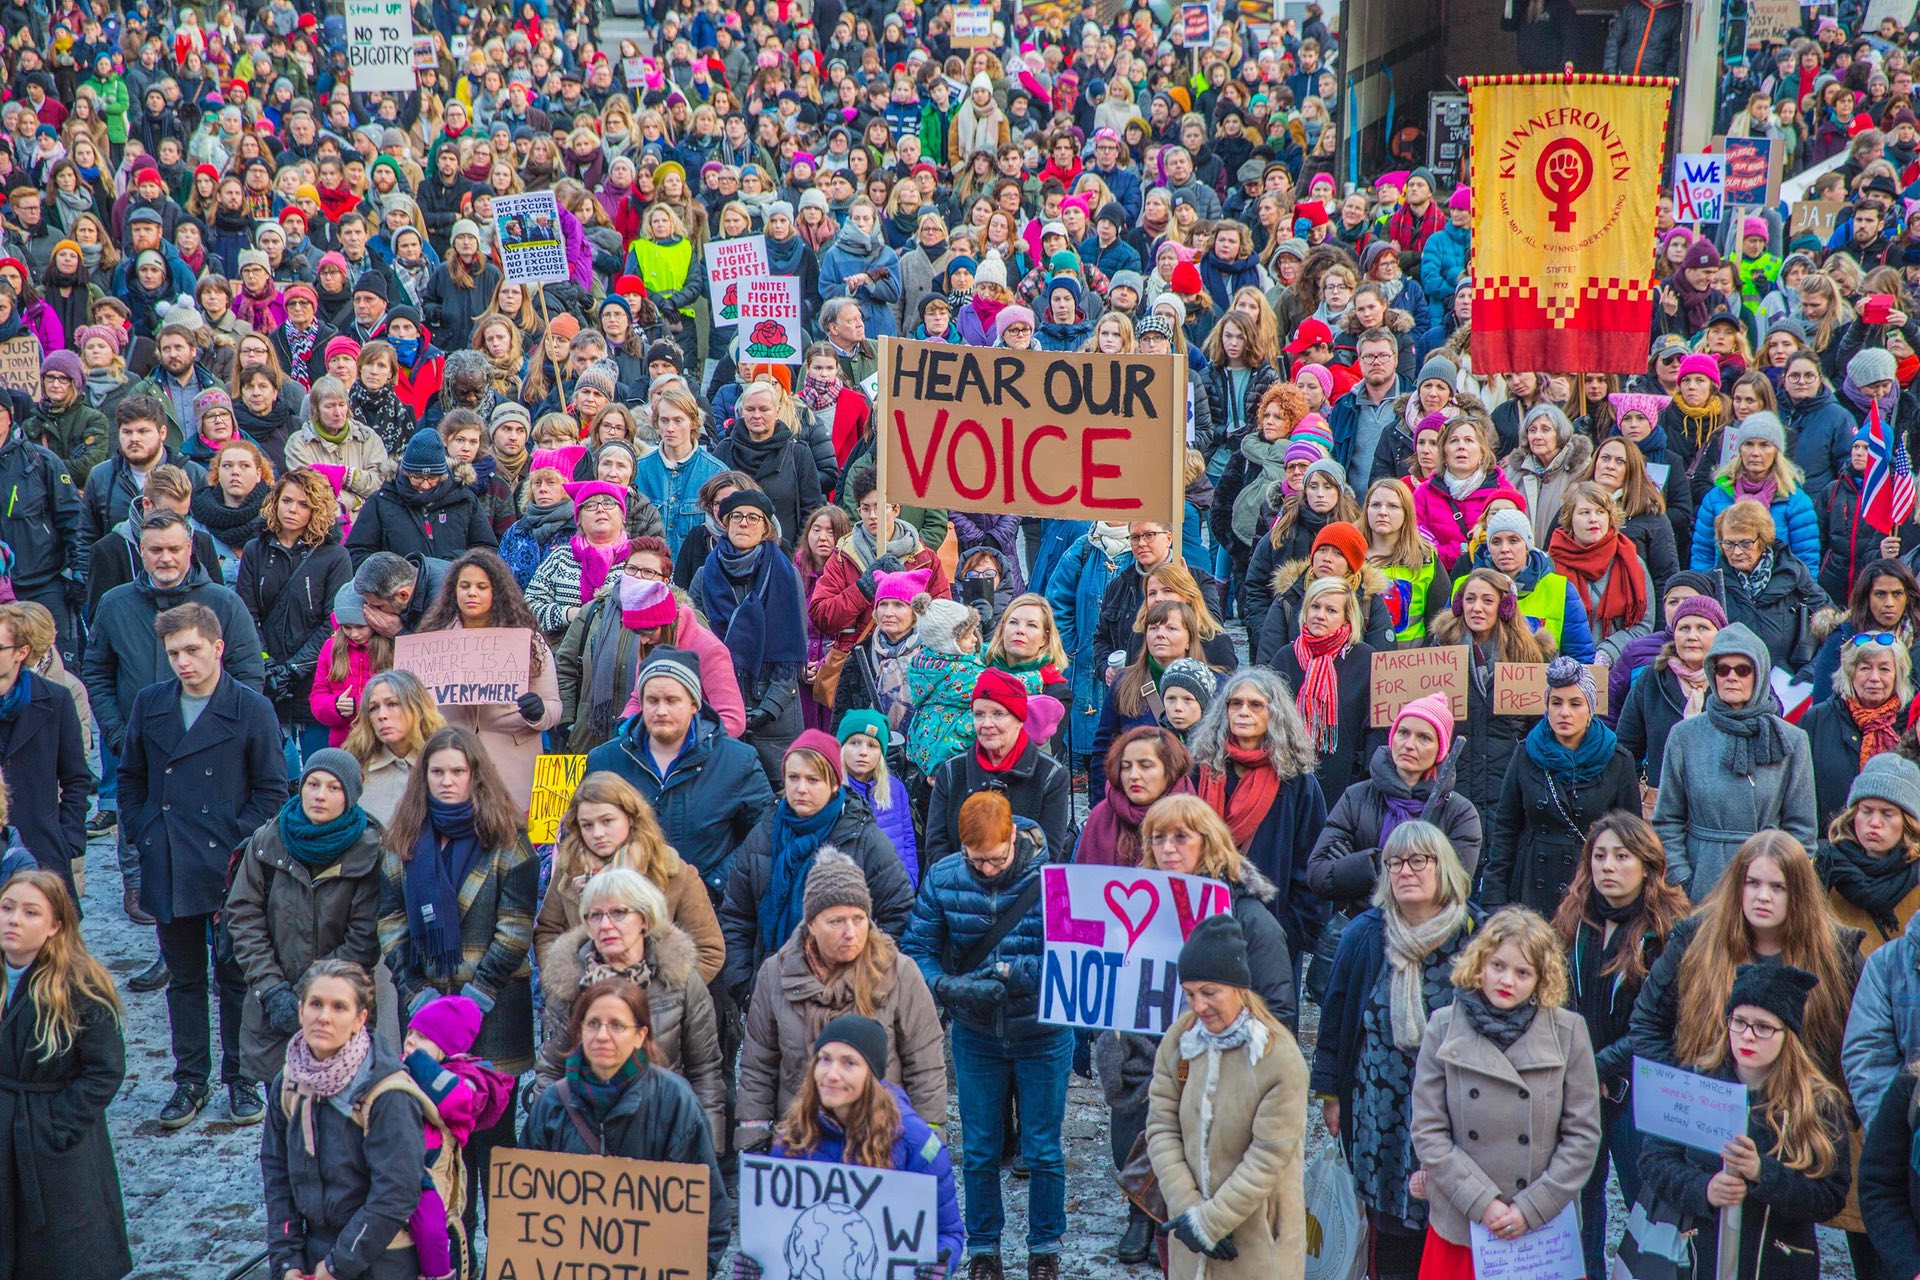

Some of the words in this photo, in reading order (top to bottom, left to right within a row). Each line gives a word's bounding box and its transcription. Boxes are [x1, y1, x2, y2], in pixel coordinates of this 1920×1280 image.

[386, 4, 402, 14] UP!
[354, 26, 373, 41] NO
[380, 27, 399, 41] TO
[350, 46, 412, 66] BIGOTRY
[1499, 107, 1631, 183] KVINNEFRONTEN
[1683, 161, 1720, 184] WE
[1675, 178, 1722, 220] HIGH
[1692, 187, 1714, 200] GO
[514, 202, 555, 211] EXCUSE
[1499, 191, 1511, 216] KAMP
[1798, 204, 1820, 227] JA
[523, 250, 563, 259] EXCUSE
[718, 242, 753, 256] UNITE!
[524, 256, 564, 266] EXCUSE
[526, 263, 566, 272] EXCUSE
[716, 251, 758, 268] FIGHT!
[711, 262, 766, 282] RESIST!
[751, 282, 786, 292] UNITE!
[748, 292, 790, 304] FIGHT!
[741, 304, 797, 318] RESIST!
[2, 340, 36, 355] JUST
[892, 344, 1031, 409] HEAR
[1043, 359, 1158, 418] OUR
[893, 408, 1143, 509] VOICE
[406, 636, 504, 658] INJUSTICE
[480, 653, 498, 670] IS
[503, 652, 518, 670] A
[1374, 651, 1458, 670] MARCHING
[461, 671, 476, 683] TO
[1501, 664, 1538, 682] NOT
[1376, 679, 1407, 696] FOR
[1420, 672, 1456, 690] OUR
[425, 684, 520, 704] VERYWHERE
[1044, 950, 1124, 1027] NOT
[1683, 1075, 1692, 1085] I
[1700, 1080, 1732, 1096] MARCH
[1674, 1102, 1690, 1115] ARE
[1700, 1096, 1735, 1113] RIGHTS
[1664, 1112, 1690, 1128] HUMAN
[1696, 1120, 1734, 1140] RIGHTS
[492, 1161, 705, 1215] IGNORANCE
[744, 1160, 884, 1210] TODAY
[517, 1211, 566, 1248] IS
[580, 1216, 651, 1257] NOT
[498, 1258, 517, 1280] A
